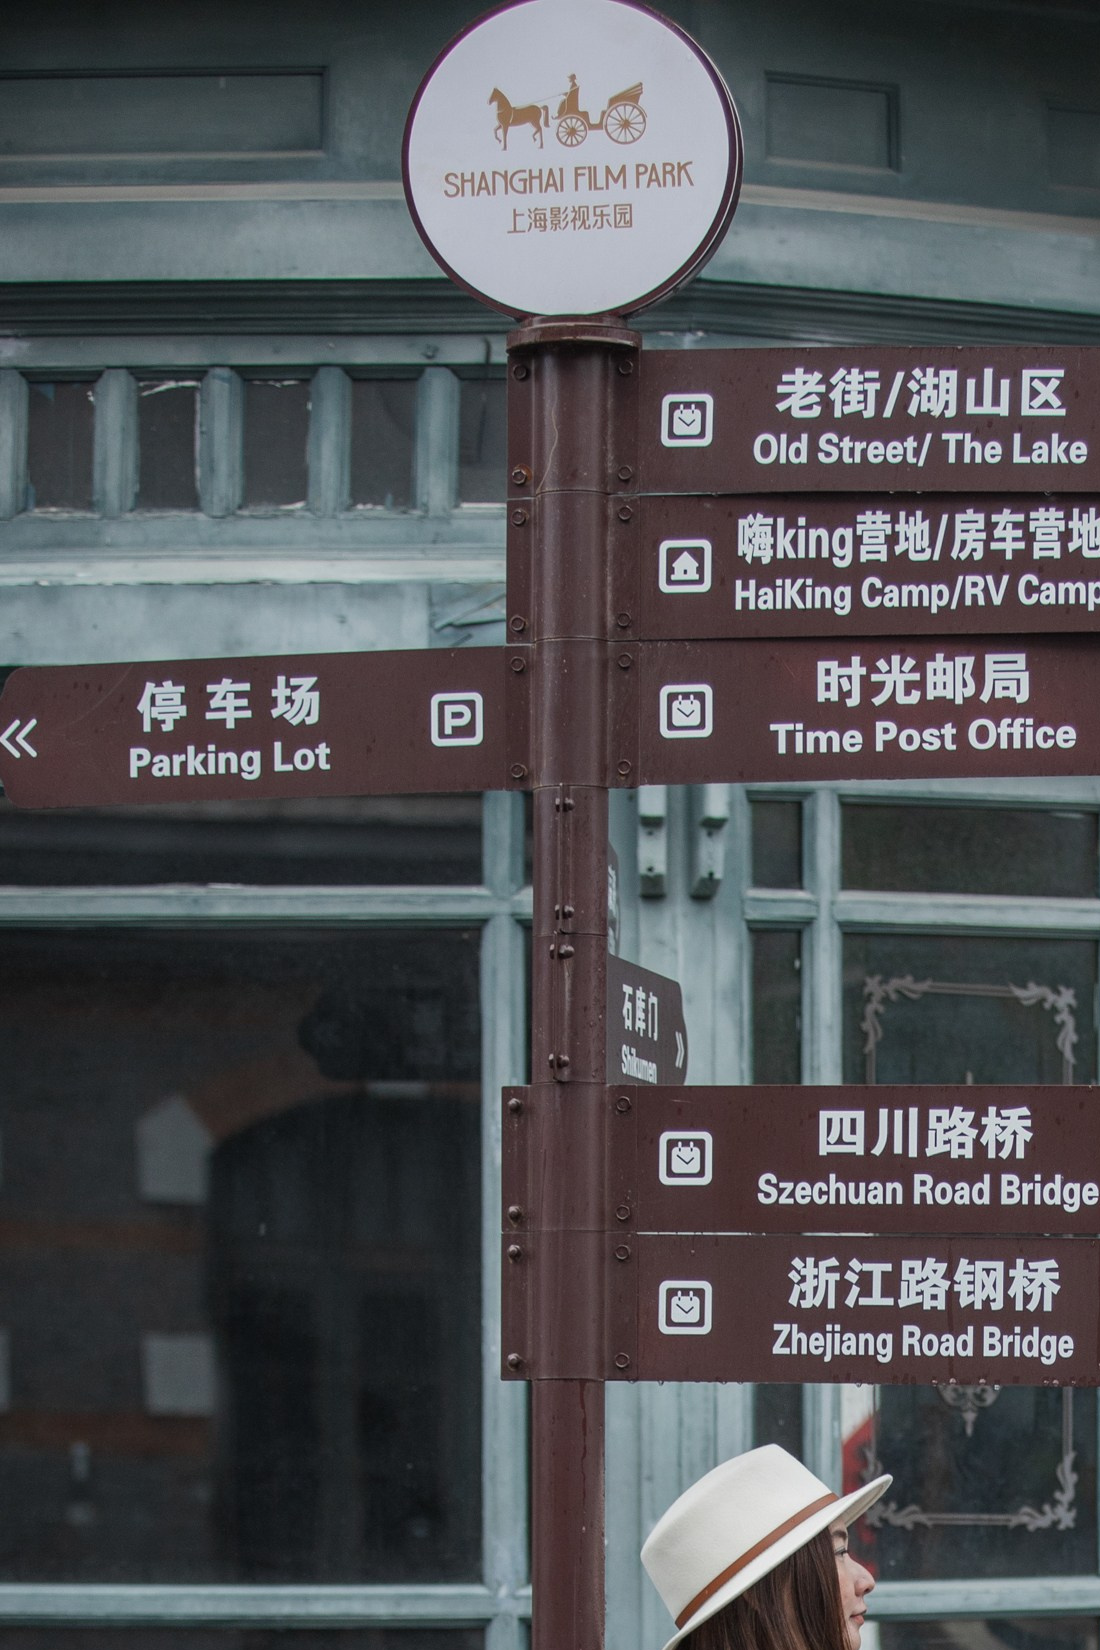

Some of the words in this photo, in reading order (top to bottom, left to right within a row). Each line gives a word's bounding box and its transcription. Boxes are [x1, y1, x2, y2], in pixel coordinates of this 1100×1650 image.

[443, 167, 564, 198] SHANGHAI
[574, 164, 627, 192] FILM
[635, 161, 694, 189] PARK
[507, 203, 633, 234] 上海影视乐园
[775, 368, 1066, 418] 老街/湖山区
[753, 433, 807, 464] Old
[817, 433, 932, 466] Street/
[942, 433, 1002, 463] The
[1012, 433, 1087, 464] Lake
[734, 577, 851, 615] HaiKing
[860, 574, 1007, 613] Camp/RV
[816, 652, 1030, 706] 时光邮局
[137, 675, 320, 732] 停车场
[444, 705, 471, 734] P
[769, 721, 863, 754] Time
[875, 719, 956, 752] Post
[967, 717, 1077, 751] Office
[129, 745, 260, 780] Parking
[273, 740, 330, 772] Lot
[622, 983, 658, 1041] 石库门
[818, 1106, 1033, 1160] 四川路桥
[757, 1173, 903, 1205] Szechuan
[913, 1173, 990, 1205] Road
[1000, 1173, 1099, 1213] Bridge
[788, 1256, 1061, 1311] 浙江路钢桥
[772, 1323, 893, 1363] Zhejiang
[902, 1324, 974, 1357] Road
[983, 1326, 1074, 1365] Bridge
